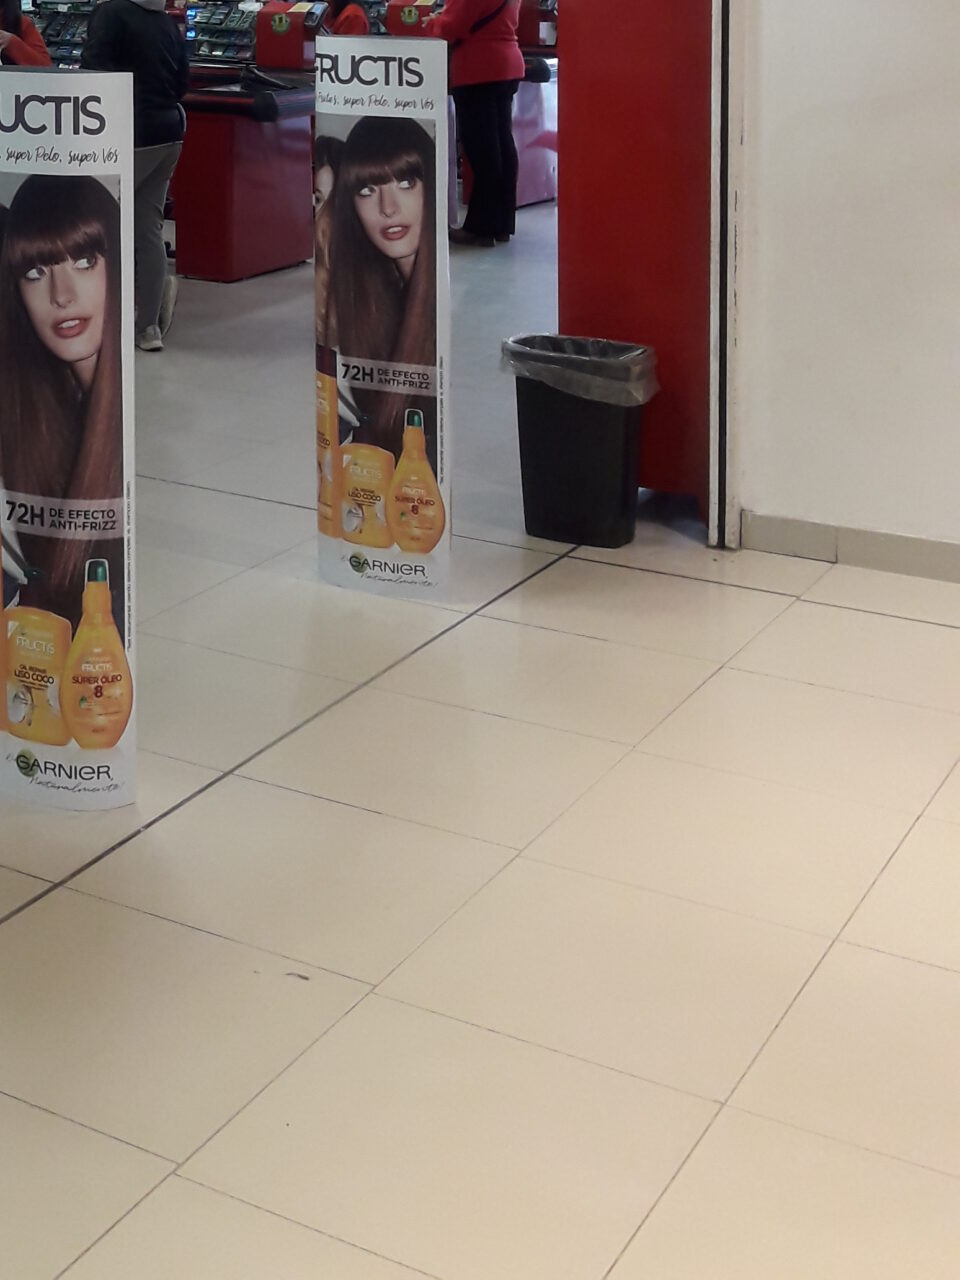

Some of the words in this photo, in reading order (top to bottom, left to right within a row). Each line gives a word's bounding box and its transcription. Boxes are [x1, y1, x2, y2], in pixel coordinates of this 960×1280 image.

[315, 53, 424, 88] RUCTIS
[6, 147, 32, 164] super
[68, 150, 99, 167] super
[341, 363, 374, 384] 72H
[378, 368, 390, 377] DE
[392, 370, 429, 381] EFECTO
[6, 500, 44, 527] 72H
[50, 508, 65, 519] DE
[68, 509, 116, 520] EFECTO
[94, 685, 103, 698] 8
